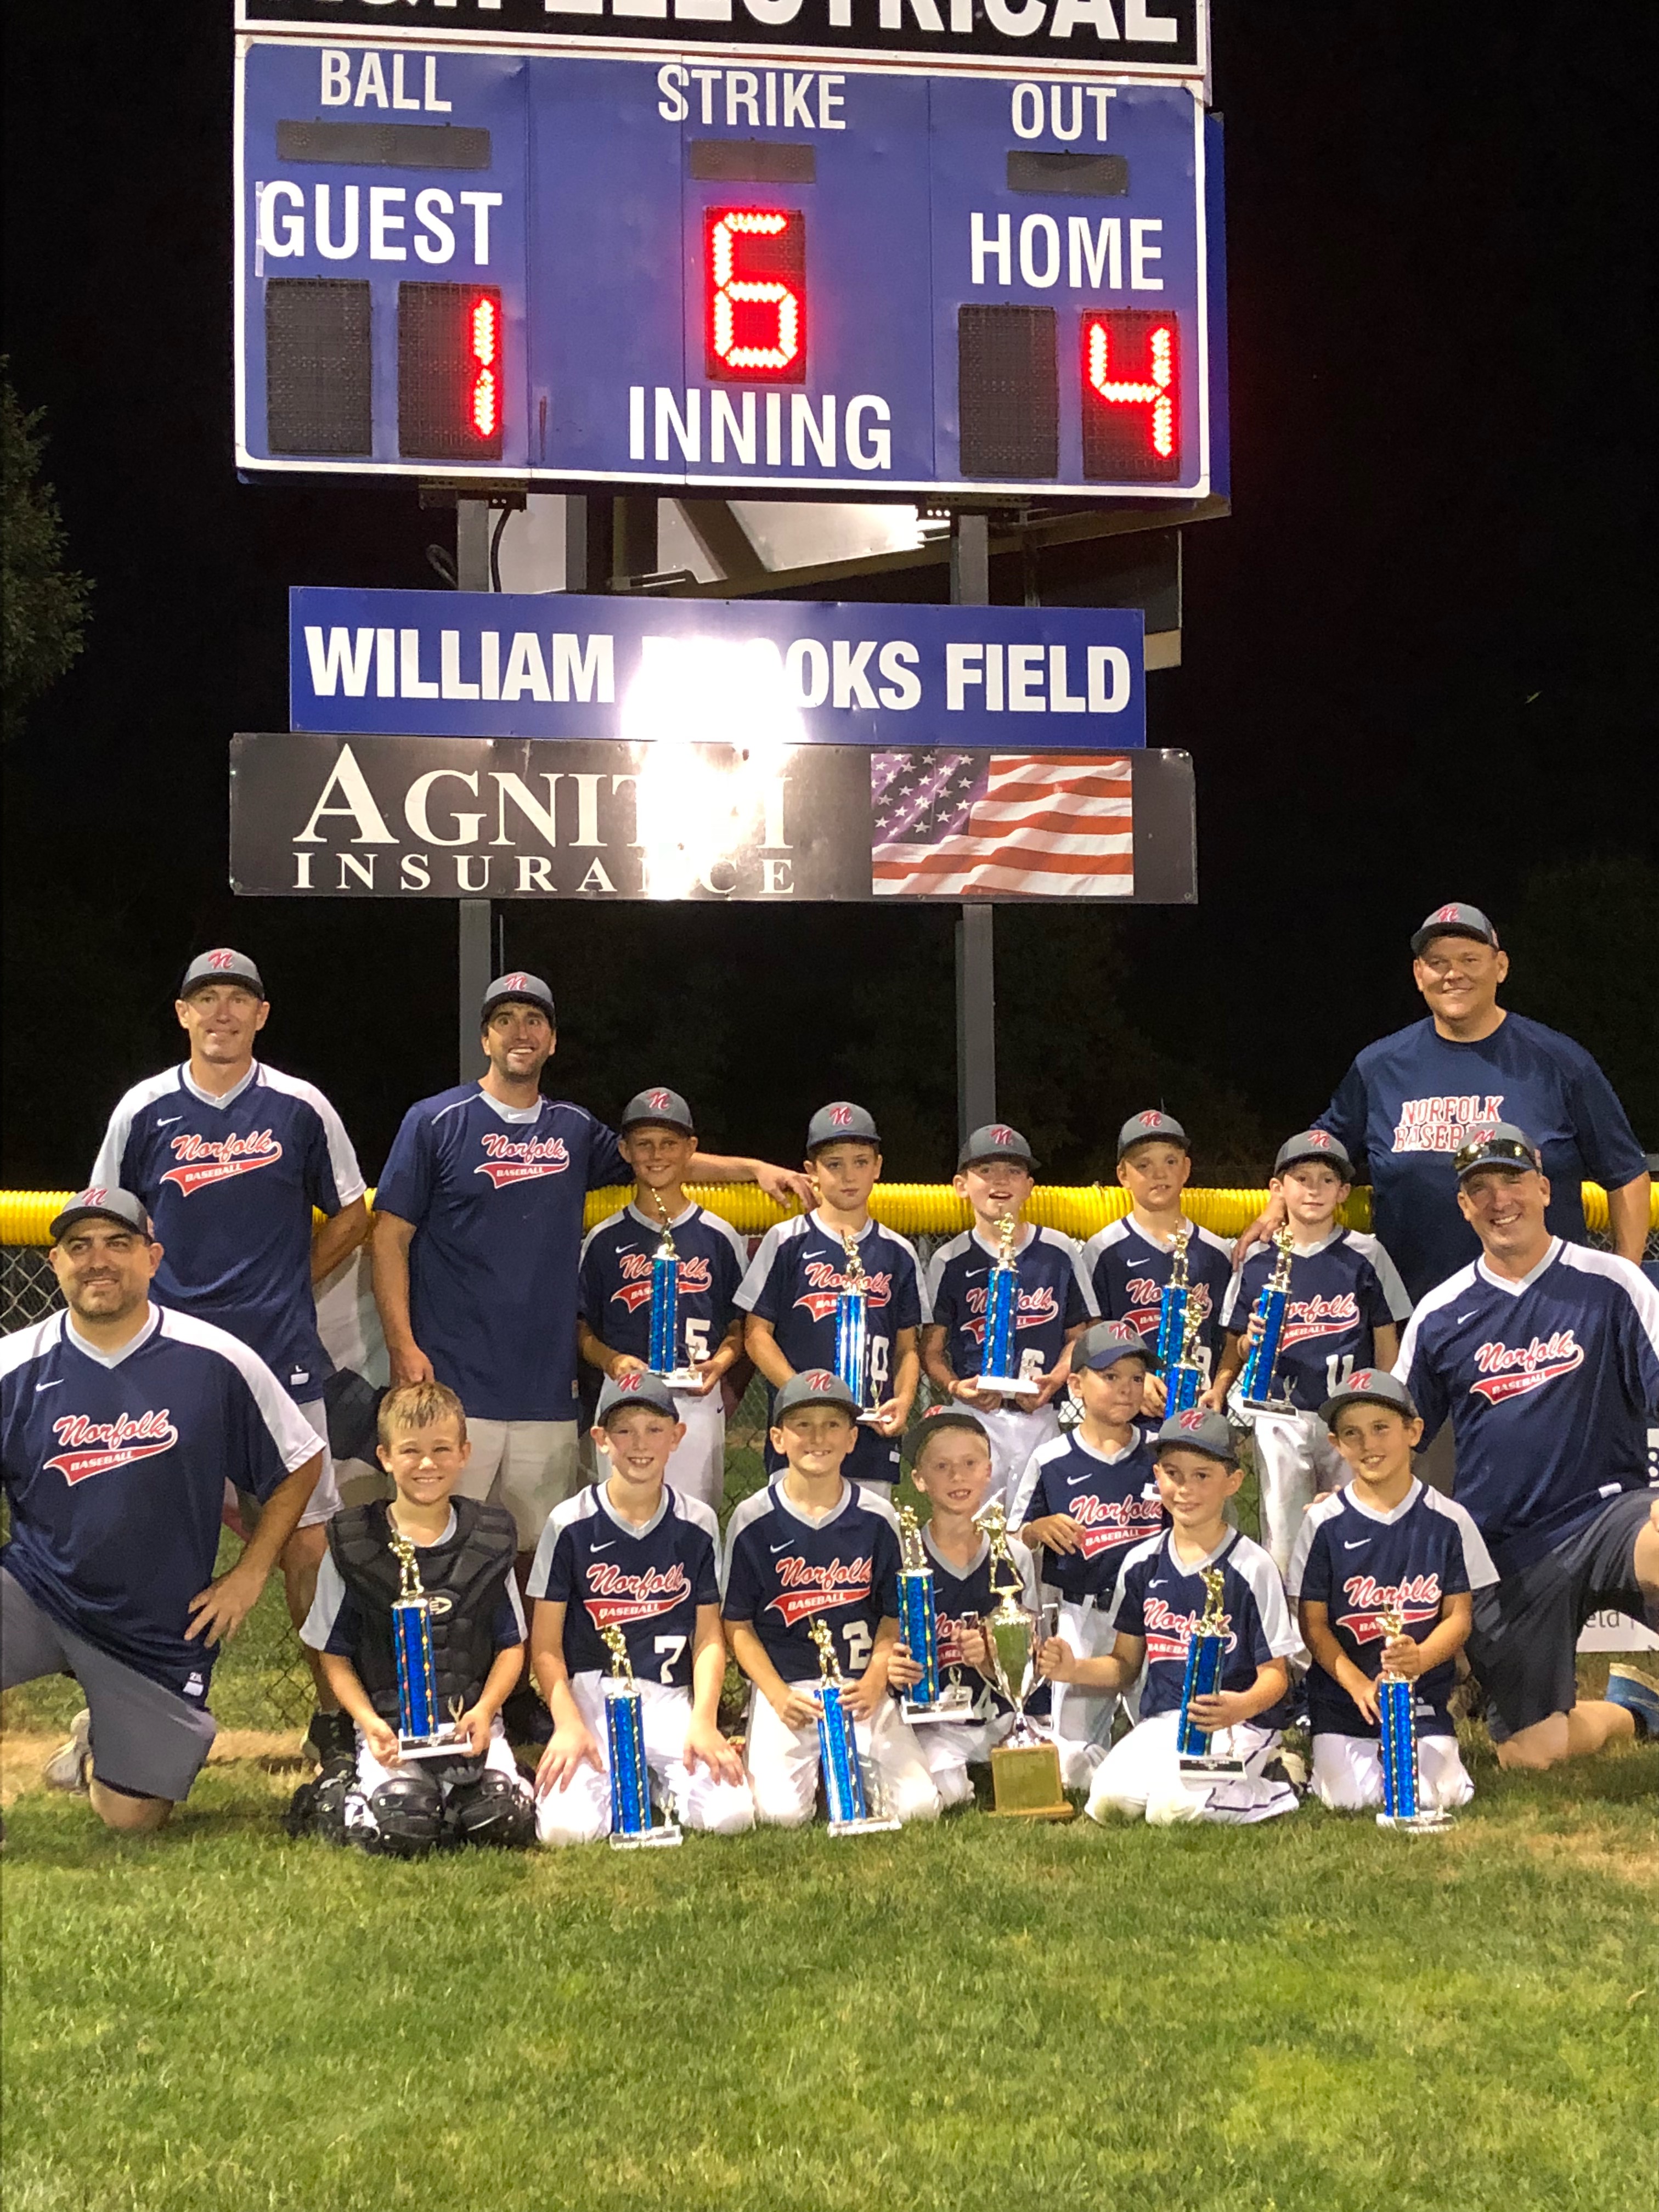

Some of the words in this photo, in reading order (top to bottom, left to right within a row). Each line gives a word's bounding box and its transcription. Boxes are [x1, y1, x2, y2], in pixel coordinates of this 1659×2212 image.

[320, 49, 453, 112] BALL
[657, 64, 847, 129] STRIKE
[1011, 82, 1117, 141] OUT
[260, 180, 503, 266] GUEST
[969, 212, 1164, 290] HOME
[712, 210, 799, 370] 6
[471, 295, 497, 438] 1
[1088, 321, 1173, 458] 4
[628, 386, 892, 471] INNING
[304, 625, 616, 703] WILLIAM
[945, 642, 1131, 714] FIELD
[1398, 1096, 1504, 1127] NORFOLK
[171, 1128, 274, 1162] Norfolk
[481, 1133, 568, 1164] Norfolk
[1391, 1122, 1473, 1153] BASEB
[184, 1163, 243, 1182] BASEBALL
[496, 1166, 543, 1177] BASEBALL
[686, 1318, 710, 1360] 5
[1474, 1329, 1576, 1375] Norfolk
[1492, 1371, 1547, 1393] BASEBALL
[53, 1409, 170, 1449] Norfolk
[70, 1450, 133, 1472] BASEBALL
[586, 1562, 687, 1601] Norfolk
[787, 1593, 846, 1611] BASEBALL
[599, 1603, 660, 1618] BASEBALL
[654, 1635, 687, 1684] 7
[842, 1620, 872, 1669] 2
